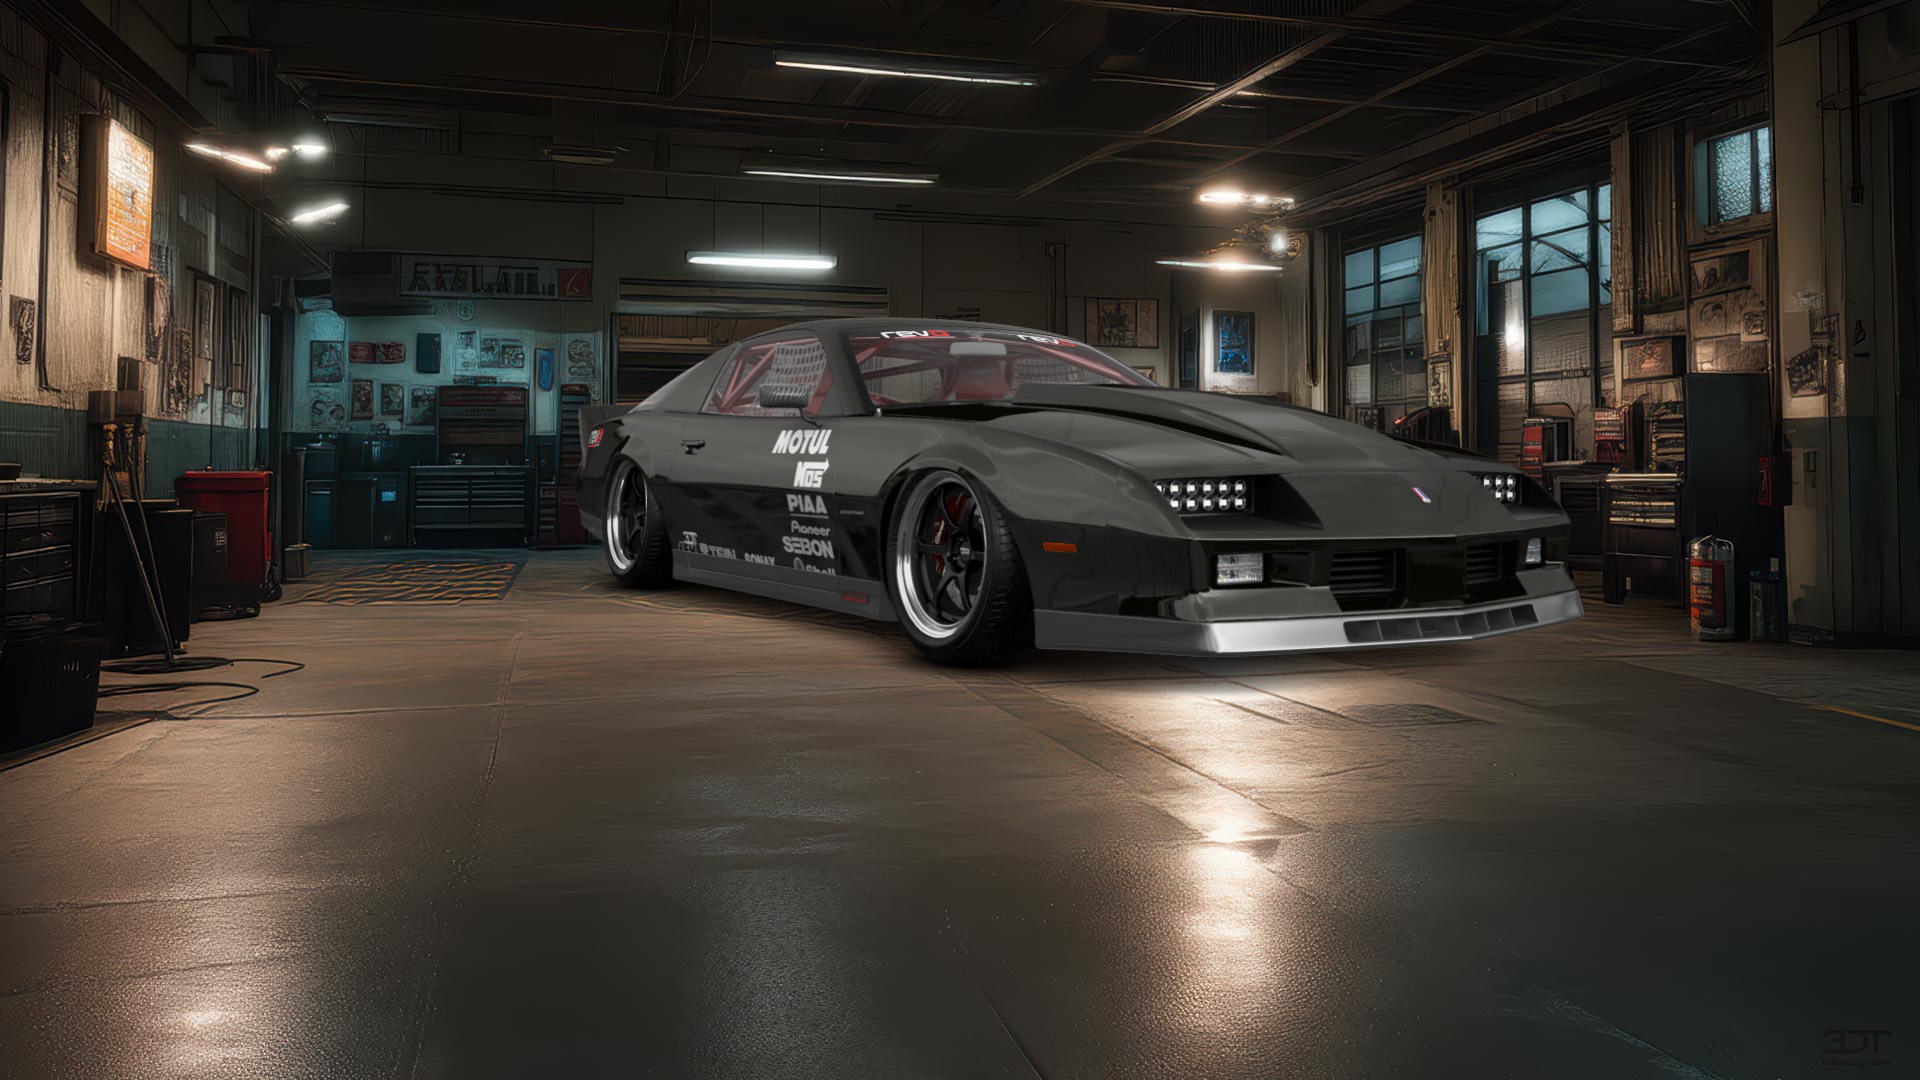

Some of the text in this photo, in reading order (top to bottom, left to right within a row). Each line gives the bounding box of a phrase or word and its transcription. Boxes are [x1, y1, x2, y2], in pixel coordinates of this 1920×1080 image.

[772, 429, 832, 455] MOTUL
[793, 459, 829, 488] NOS
[786, 493, 828, 514] PIAA
[791, 520, 831, 537] Pioneer
[782, 535, 835, 559] SEBON
